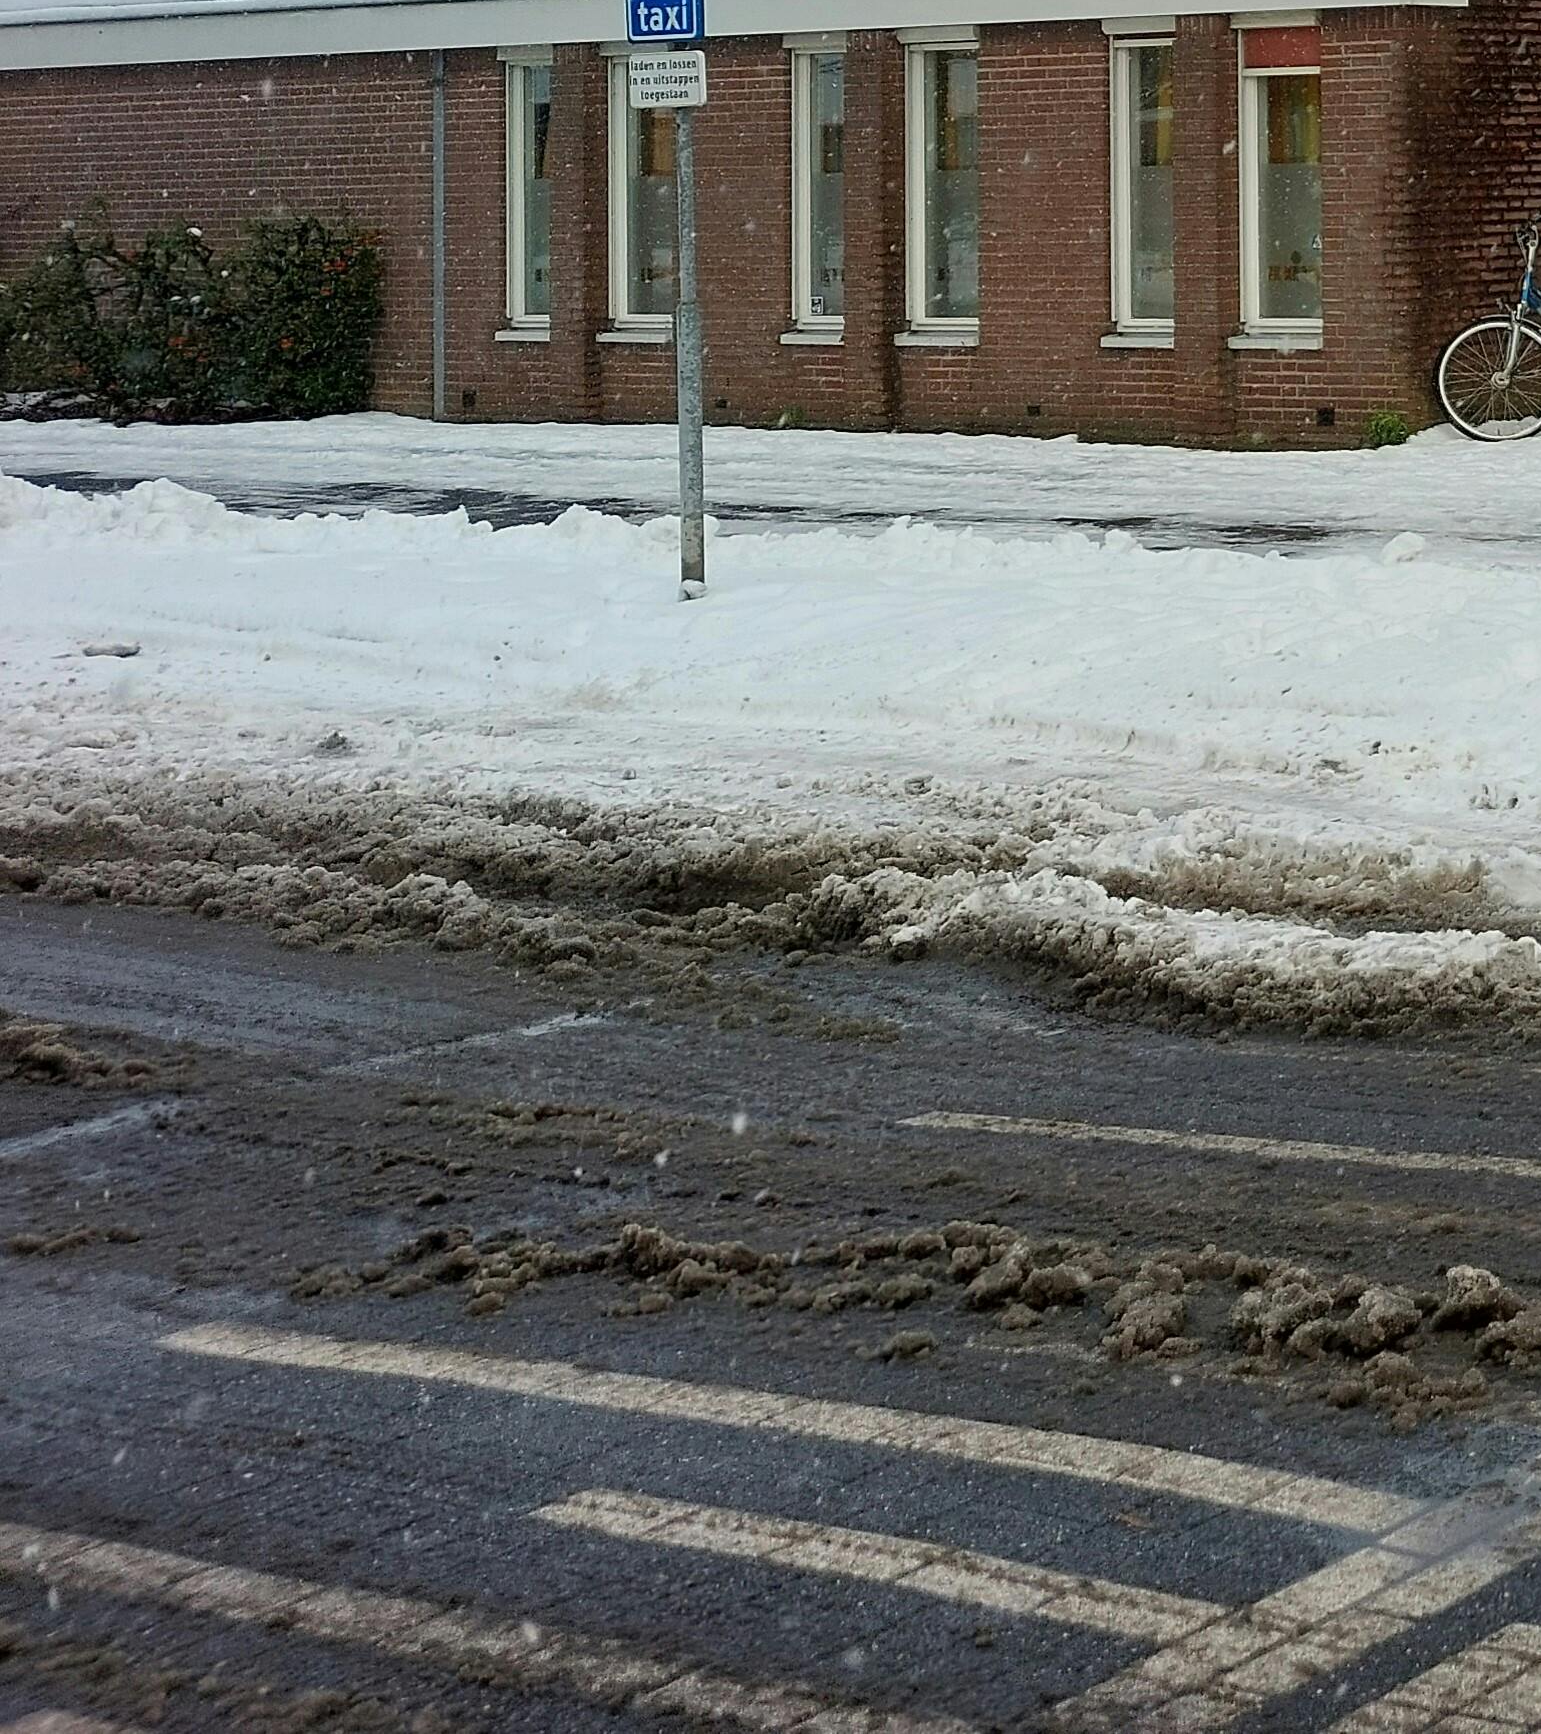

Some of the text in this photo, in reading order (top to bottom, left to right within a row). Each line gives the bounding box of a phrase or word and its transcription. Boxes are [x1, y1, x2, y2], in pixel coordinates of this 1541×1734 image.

[630, 59, 697, 71] laden en lossen
[629, 74, 699, 86] in en uitstappen
[640, 90, 689, 102] toegestaan
